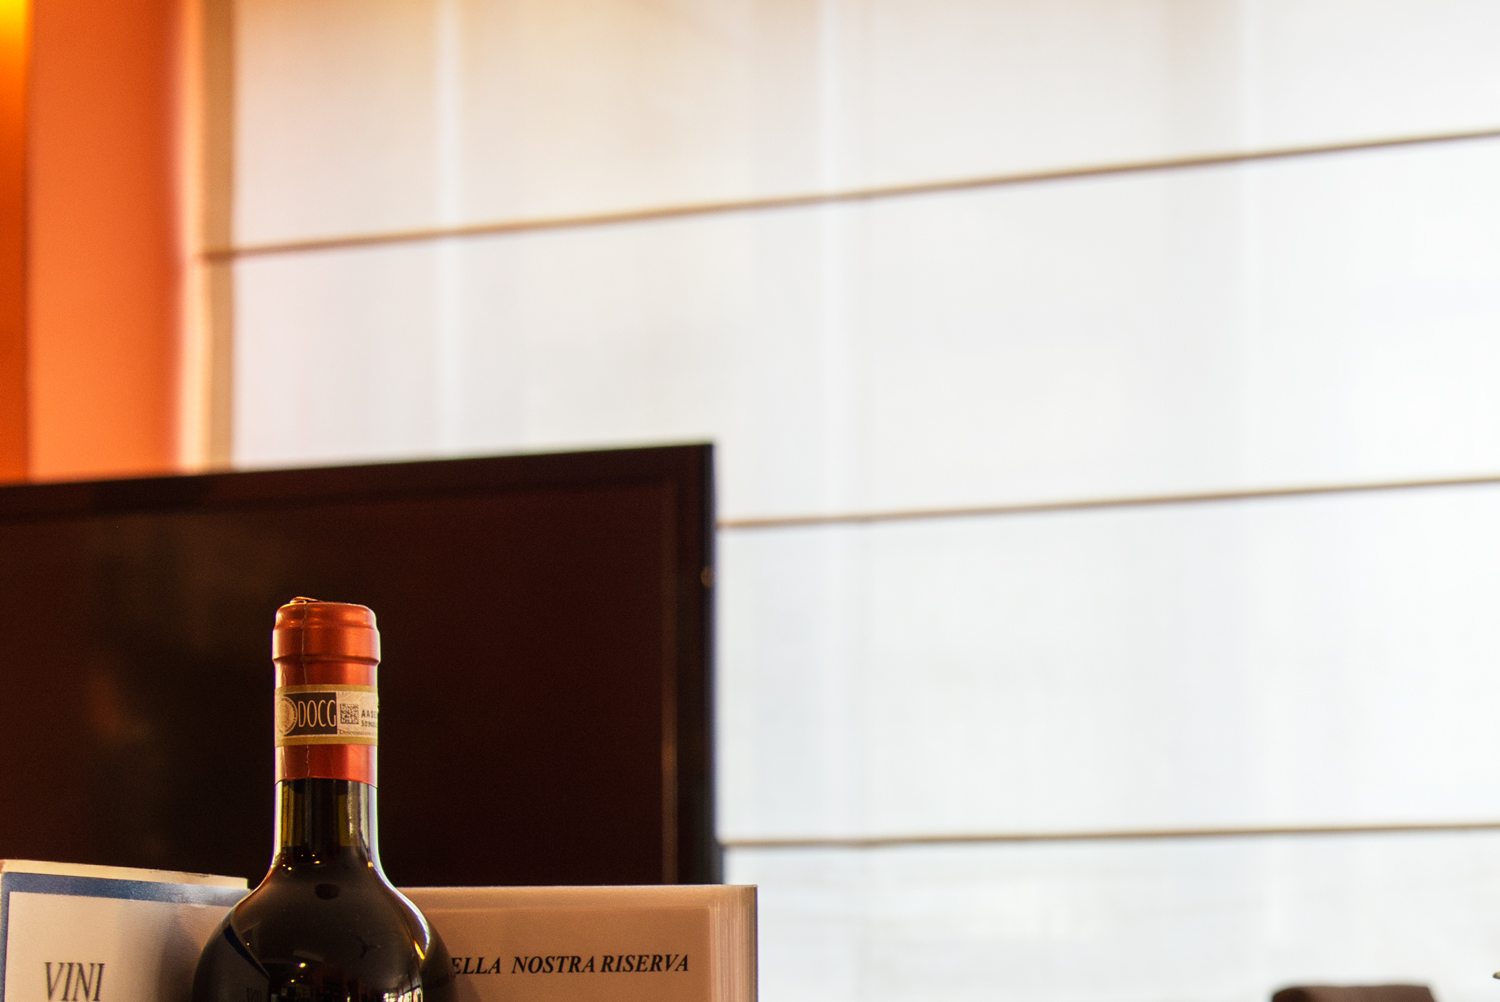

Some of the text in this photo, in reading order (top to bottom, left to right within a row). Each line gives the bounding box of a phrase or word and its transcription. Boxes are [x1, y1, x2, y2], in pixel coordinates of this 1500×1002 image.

[298, 699, 337, 727] DOCG
[450, 954, 689, 975] ELLA NOSTRA RISERVA
[44, 962, 105, 1002] VINI
